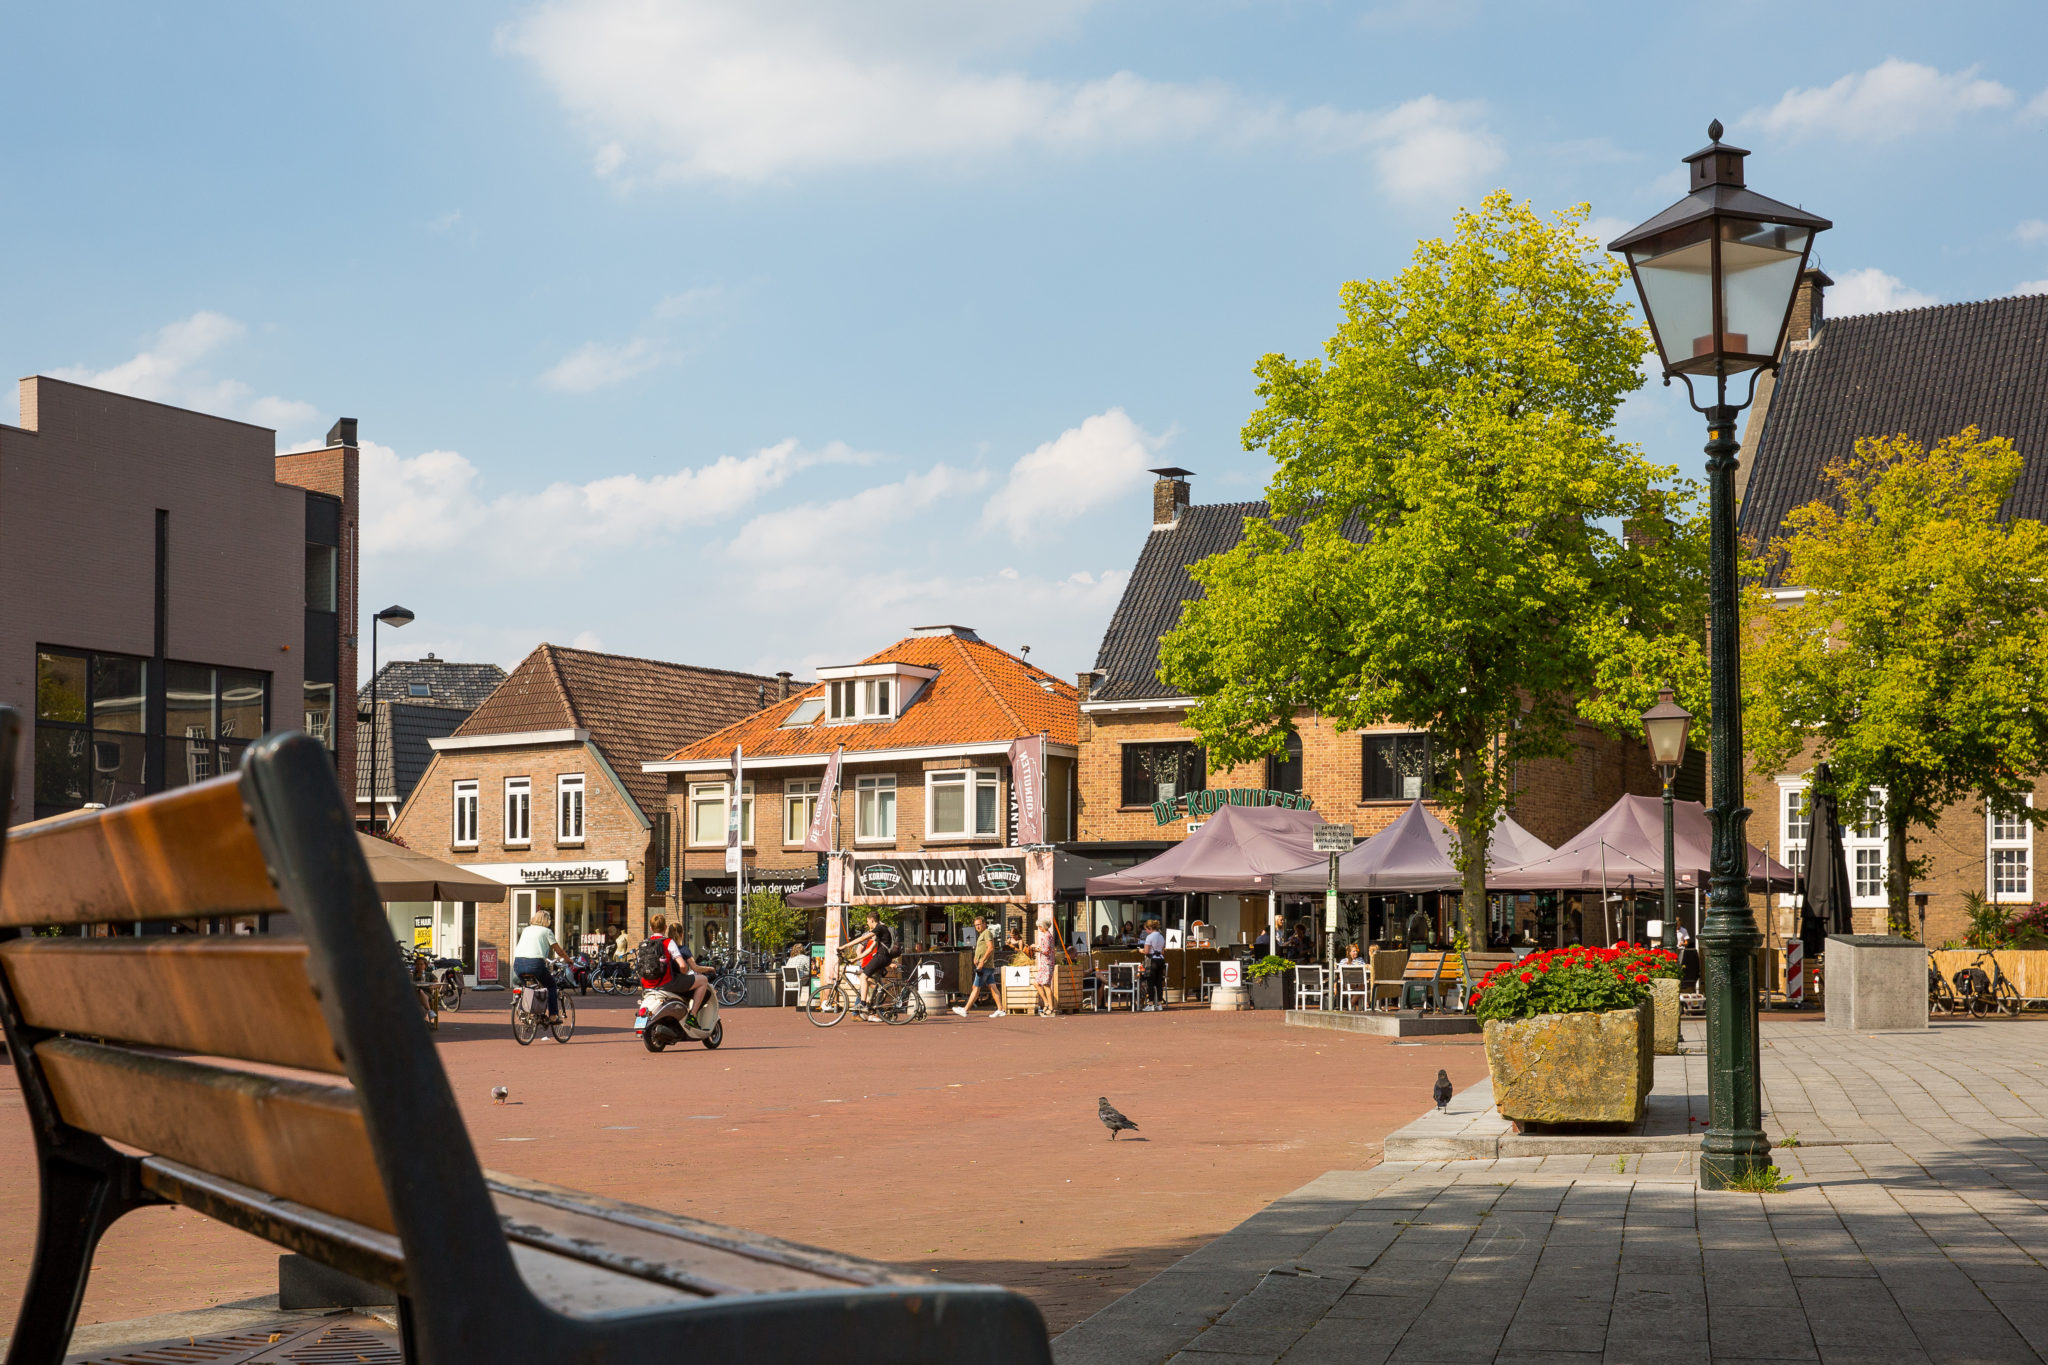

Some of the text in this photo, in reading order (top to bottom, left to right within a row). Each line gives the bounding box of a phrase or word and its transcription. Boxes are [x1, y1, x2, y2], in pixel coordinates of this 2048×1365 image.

[1151, 788, 1312, 826] DE KORNUITEN
[520, 866, 609, 878] hunkemöller
[860, 872, 901, 883] DE KORNUITEN
[911, 869, 967, 886] WELKOM
[977, 871, 1021, 883] DE KORNUITEN
[705, 882, 805, 897] oogwerld van der werf
